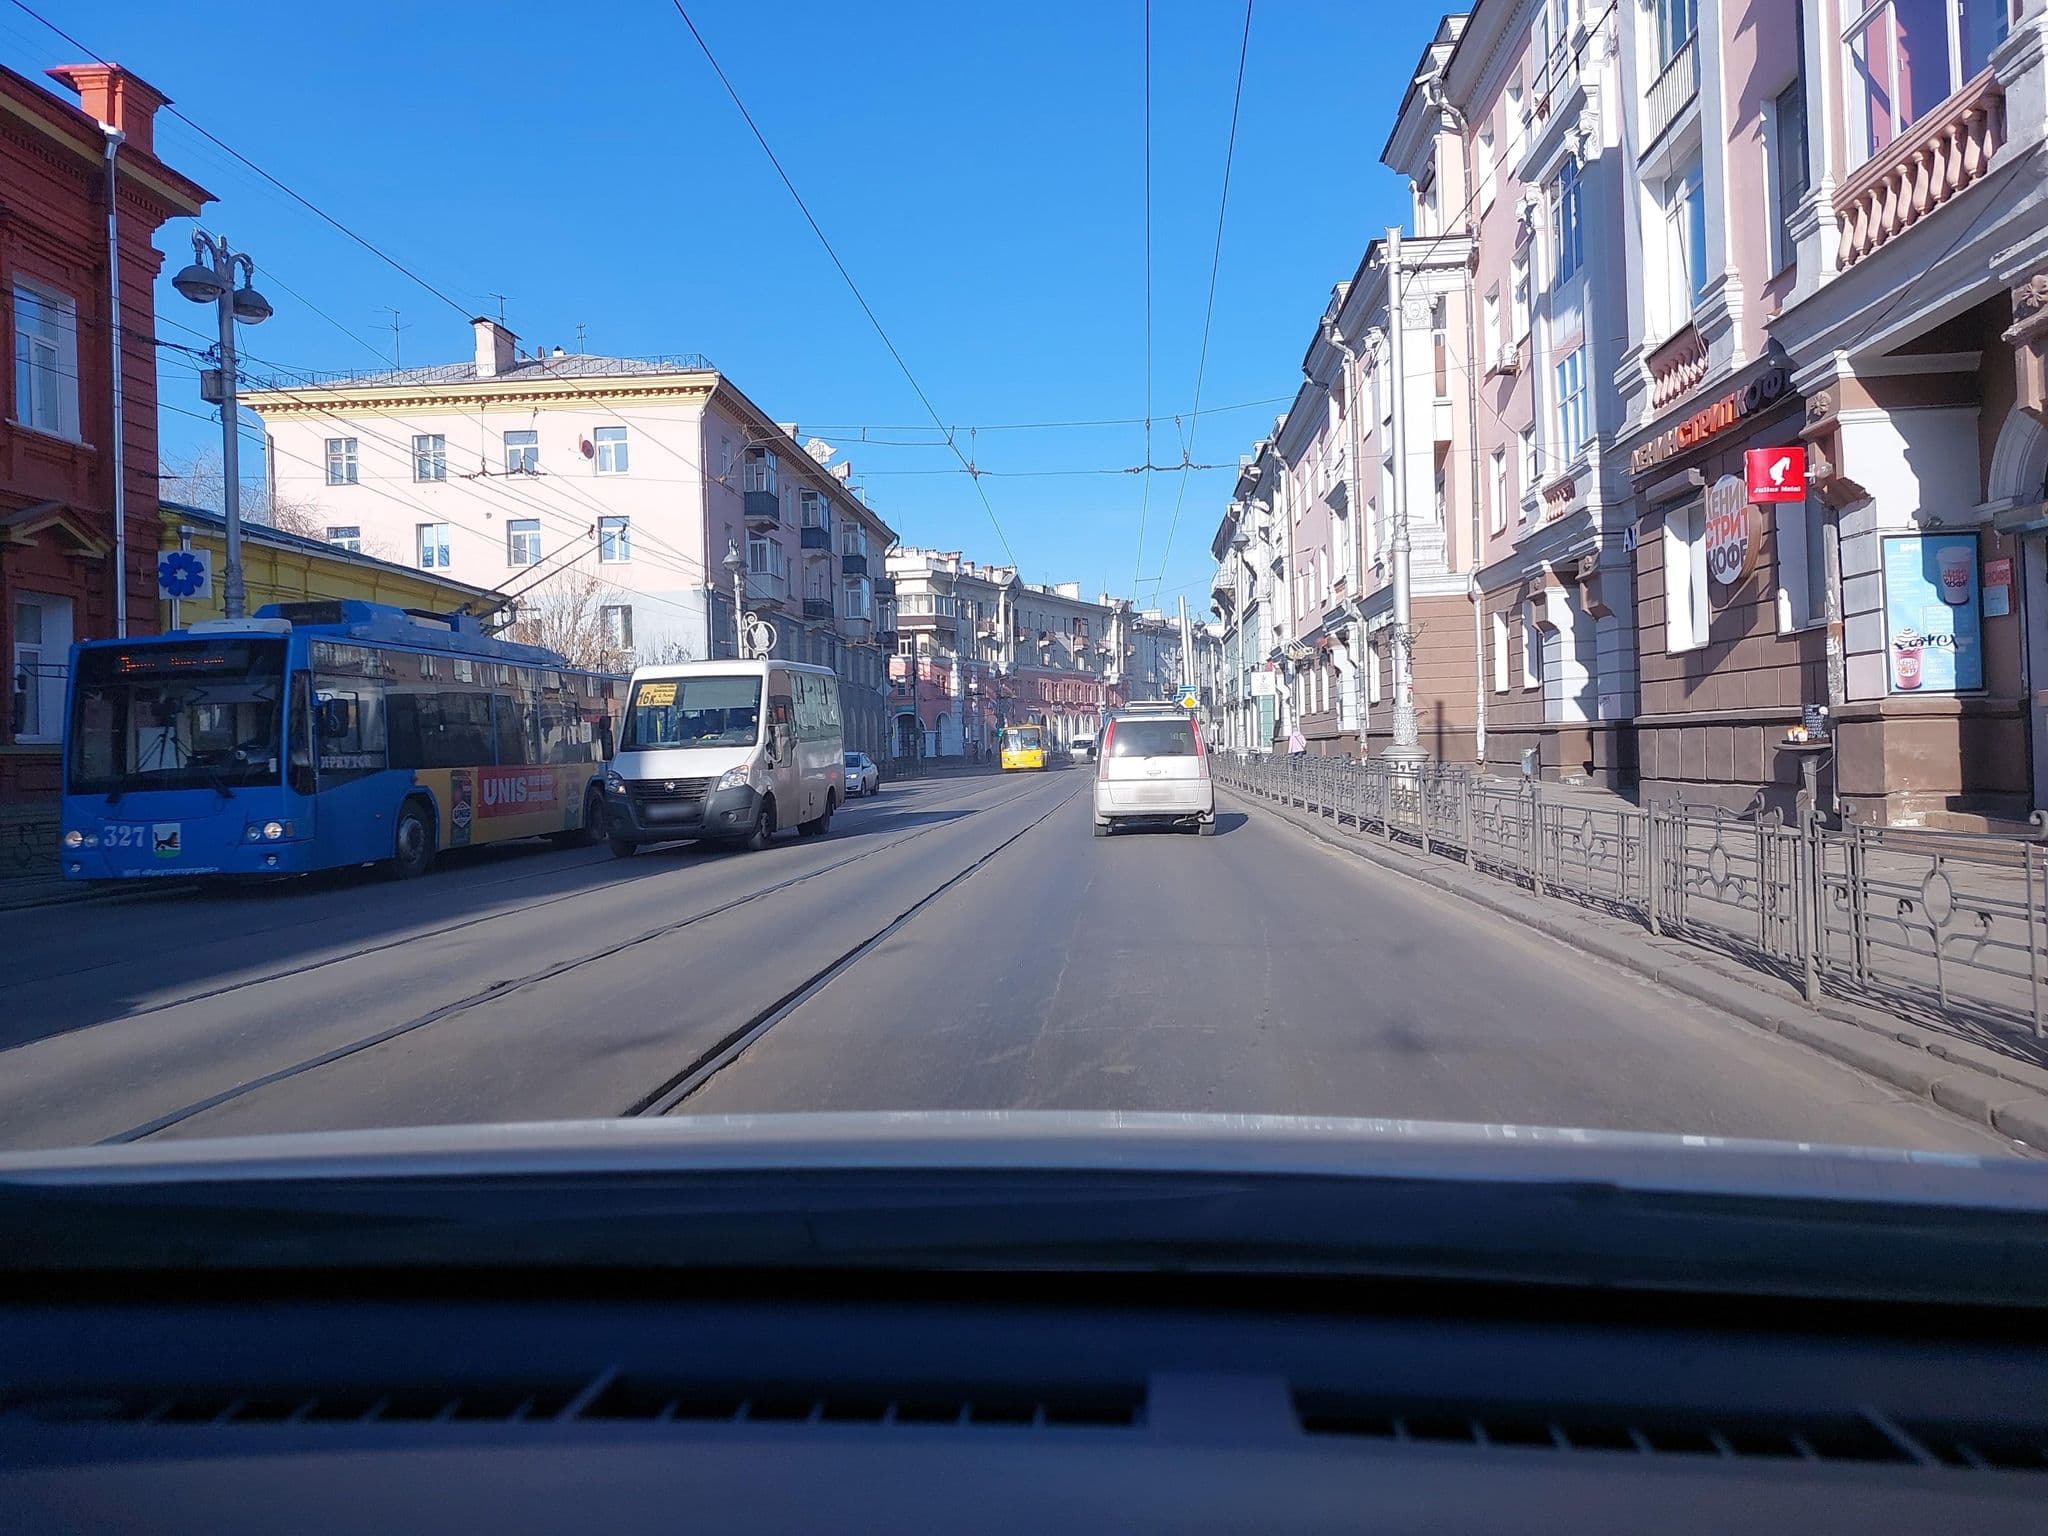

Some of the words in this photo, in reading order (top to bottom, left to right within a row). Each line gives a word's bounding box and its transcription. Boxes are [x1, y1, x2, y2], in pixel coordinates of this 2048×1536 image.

[1706, 506, 1749, 549] СТРИТ
[483, 776, 528, 806] UNIS
[103, 825, 145, 848] 327
